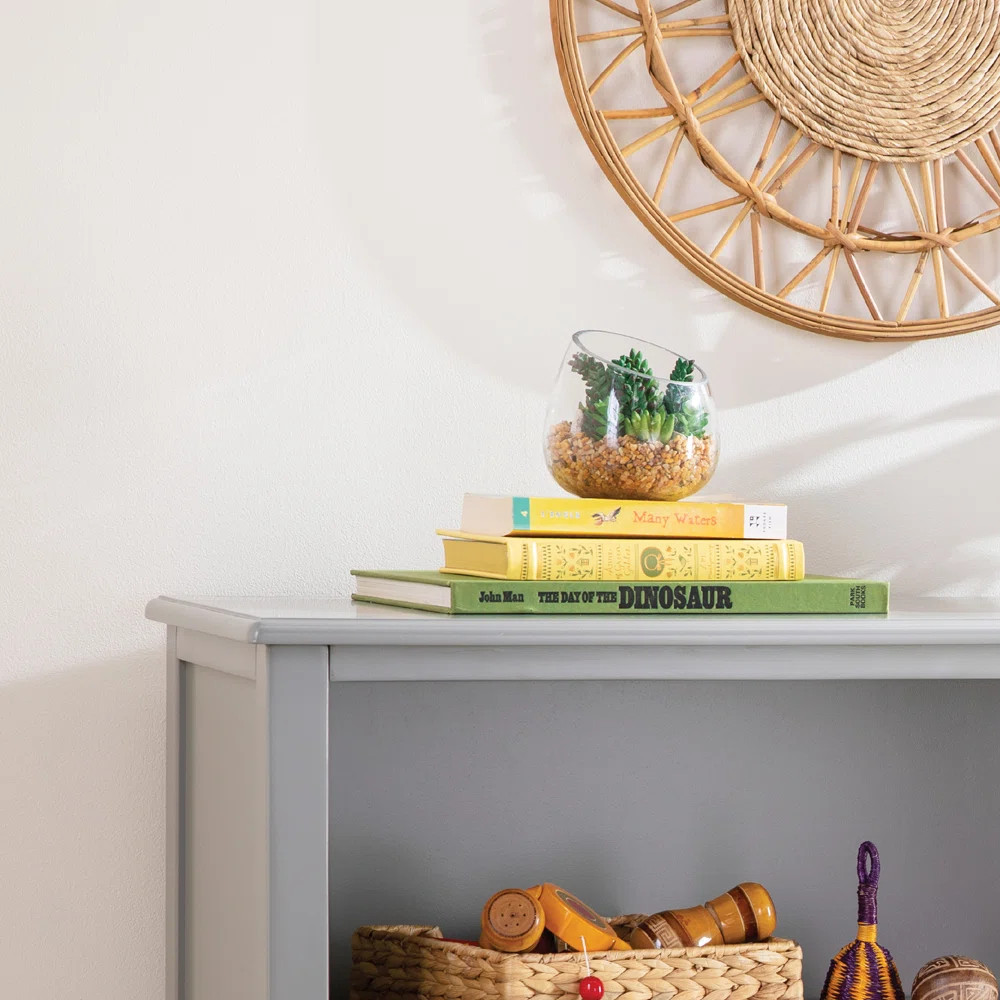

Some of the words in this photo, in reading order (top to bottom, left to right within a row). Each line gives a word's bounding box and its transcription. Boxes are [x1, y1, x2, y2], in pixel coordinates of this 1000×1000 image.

[633, 510, 670, 529] Many
[674, 512, 718, 527] Waters
[478, 590, 502, 603] John
[503, 590, 525, 603] Man
[537, 591, 559, 603] THE
[560, 591, 581, 603] DAY
[581, 591, 595, 603] OF
[596, 591, 617, 603] THE
[618, 585, 733, 609] DINOSAUR
